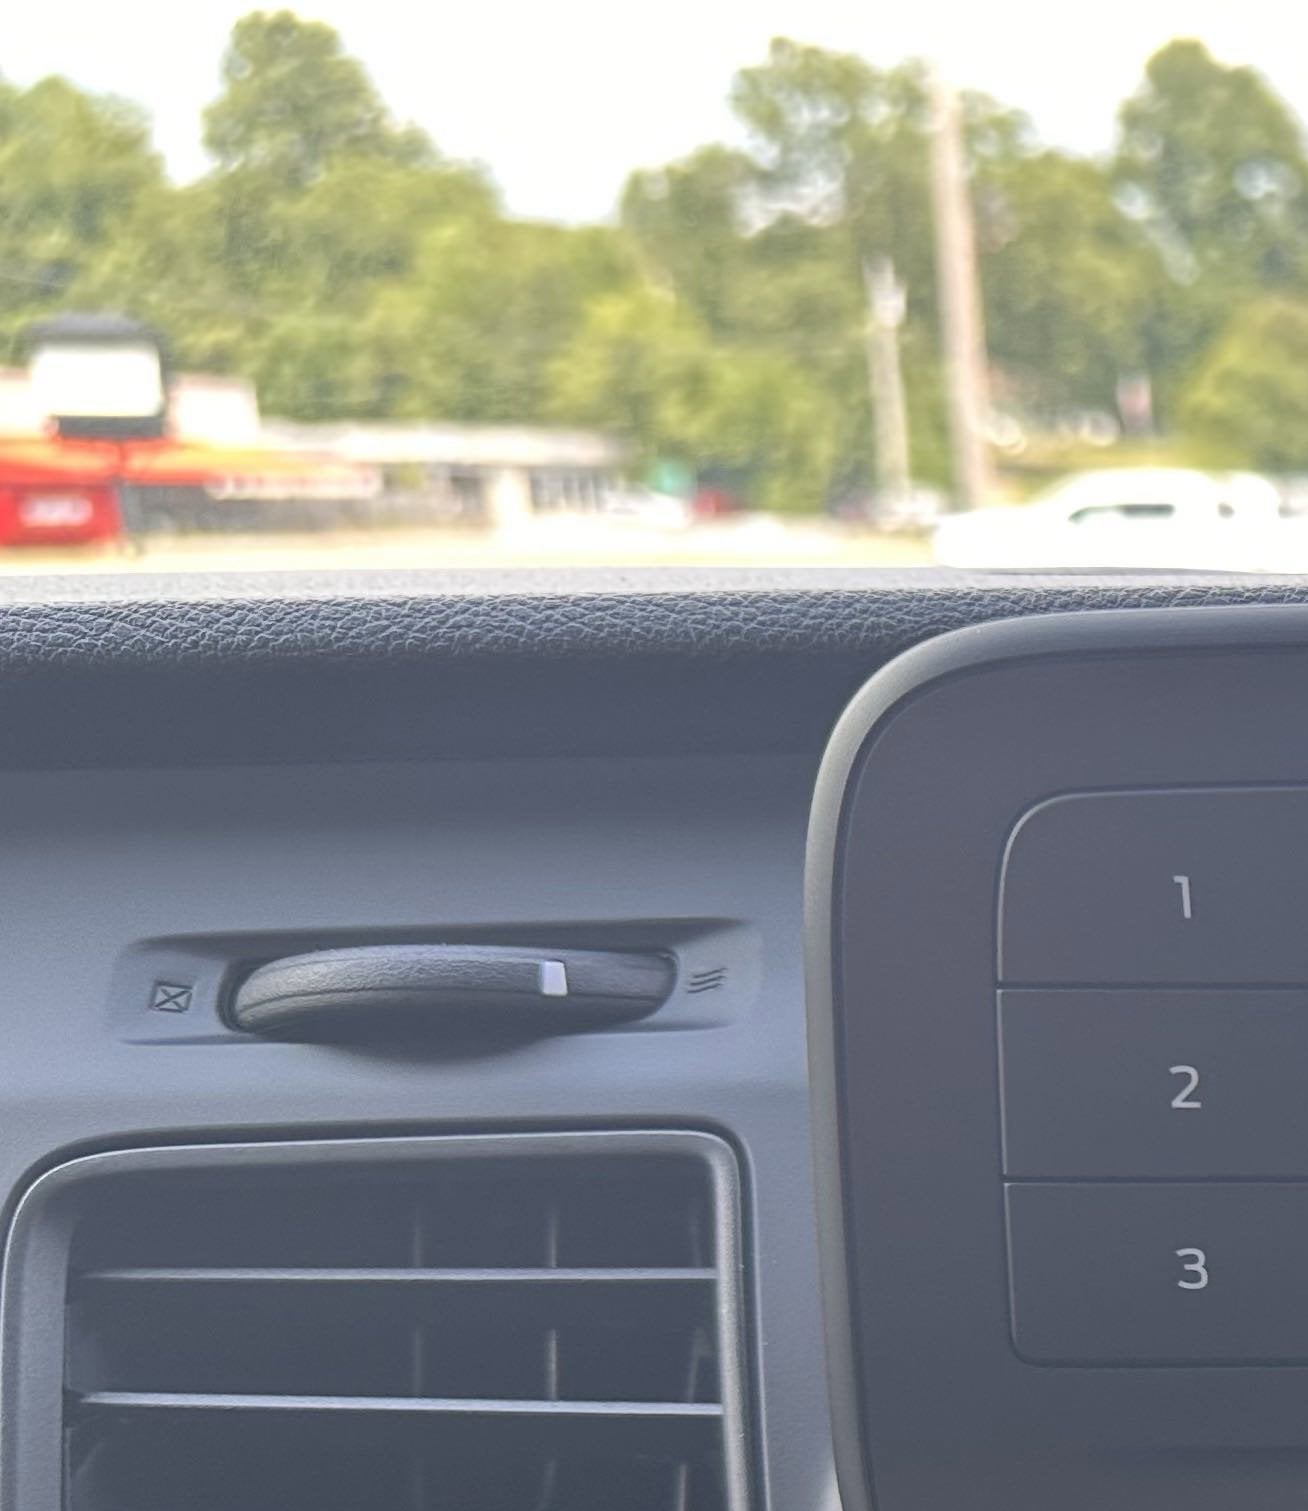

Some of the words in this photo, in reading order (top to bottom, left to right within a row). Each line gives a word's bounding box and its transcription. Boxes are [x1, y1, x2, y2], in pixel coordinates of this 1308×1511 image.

[1173, 875, 1192, 919] 1
[1168, 1065, 1202, 1108] 2
[1174, 1247, 1209, 1290] 3
